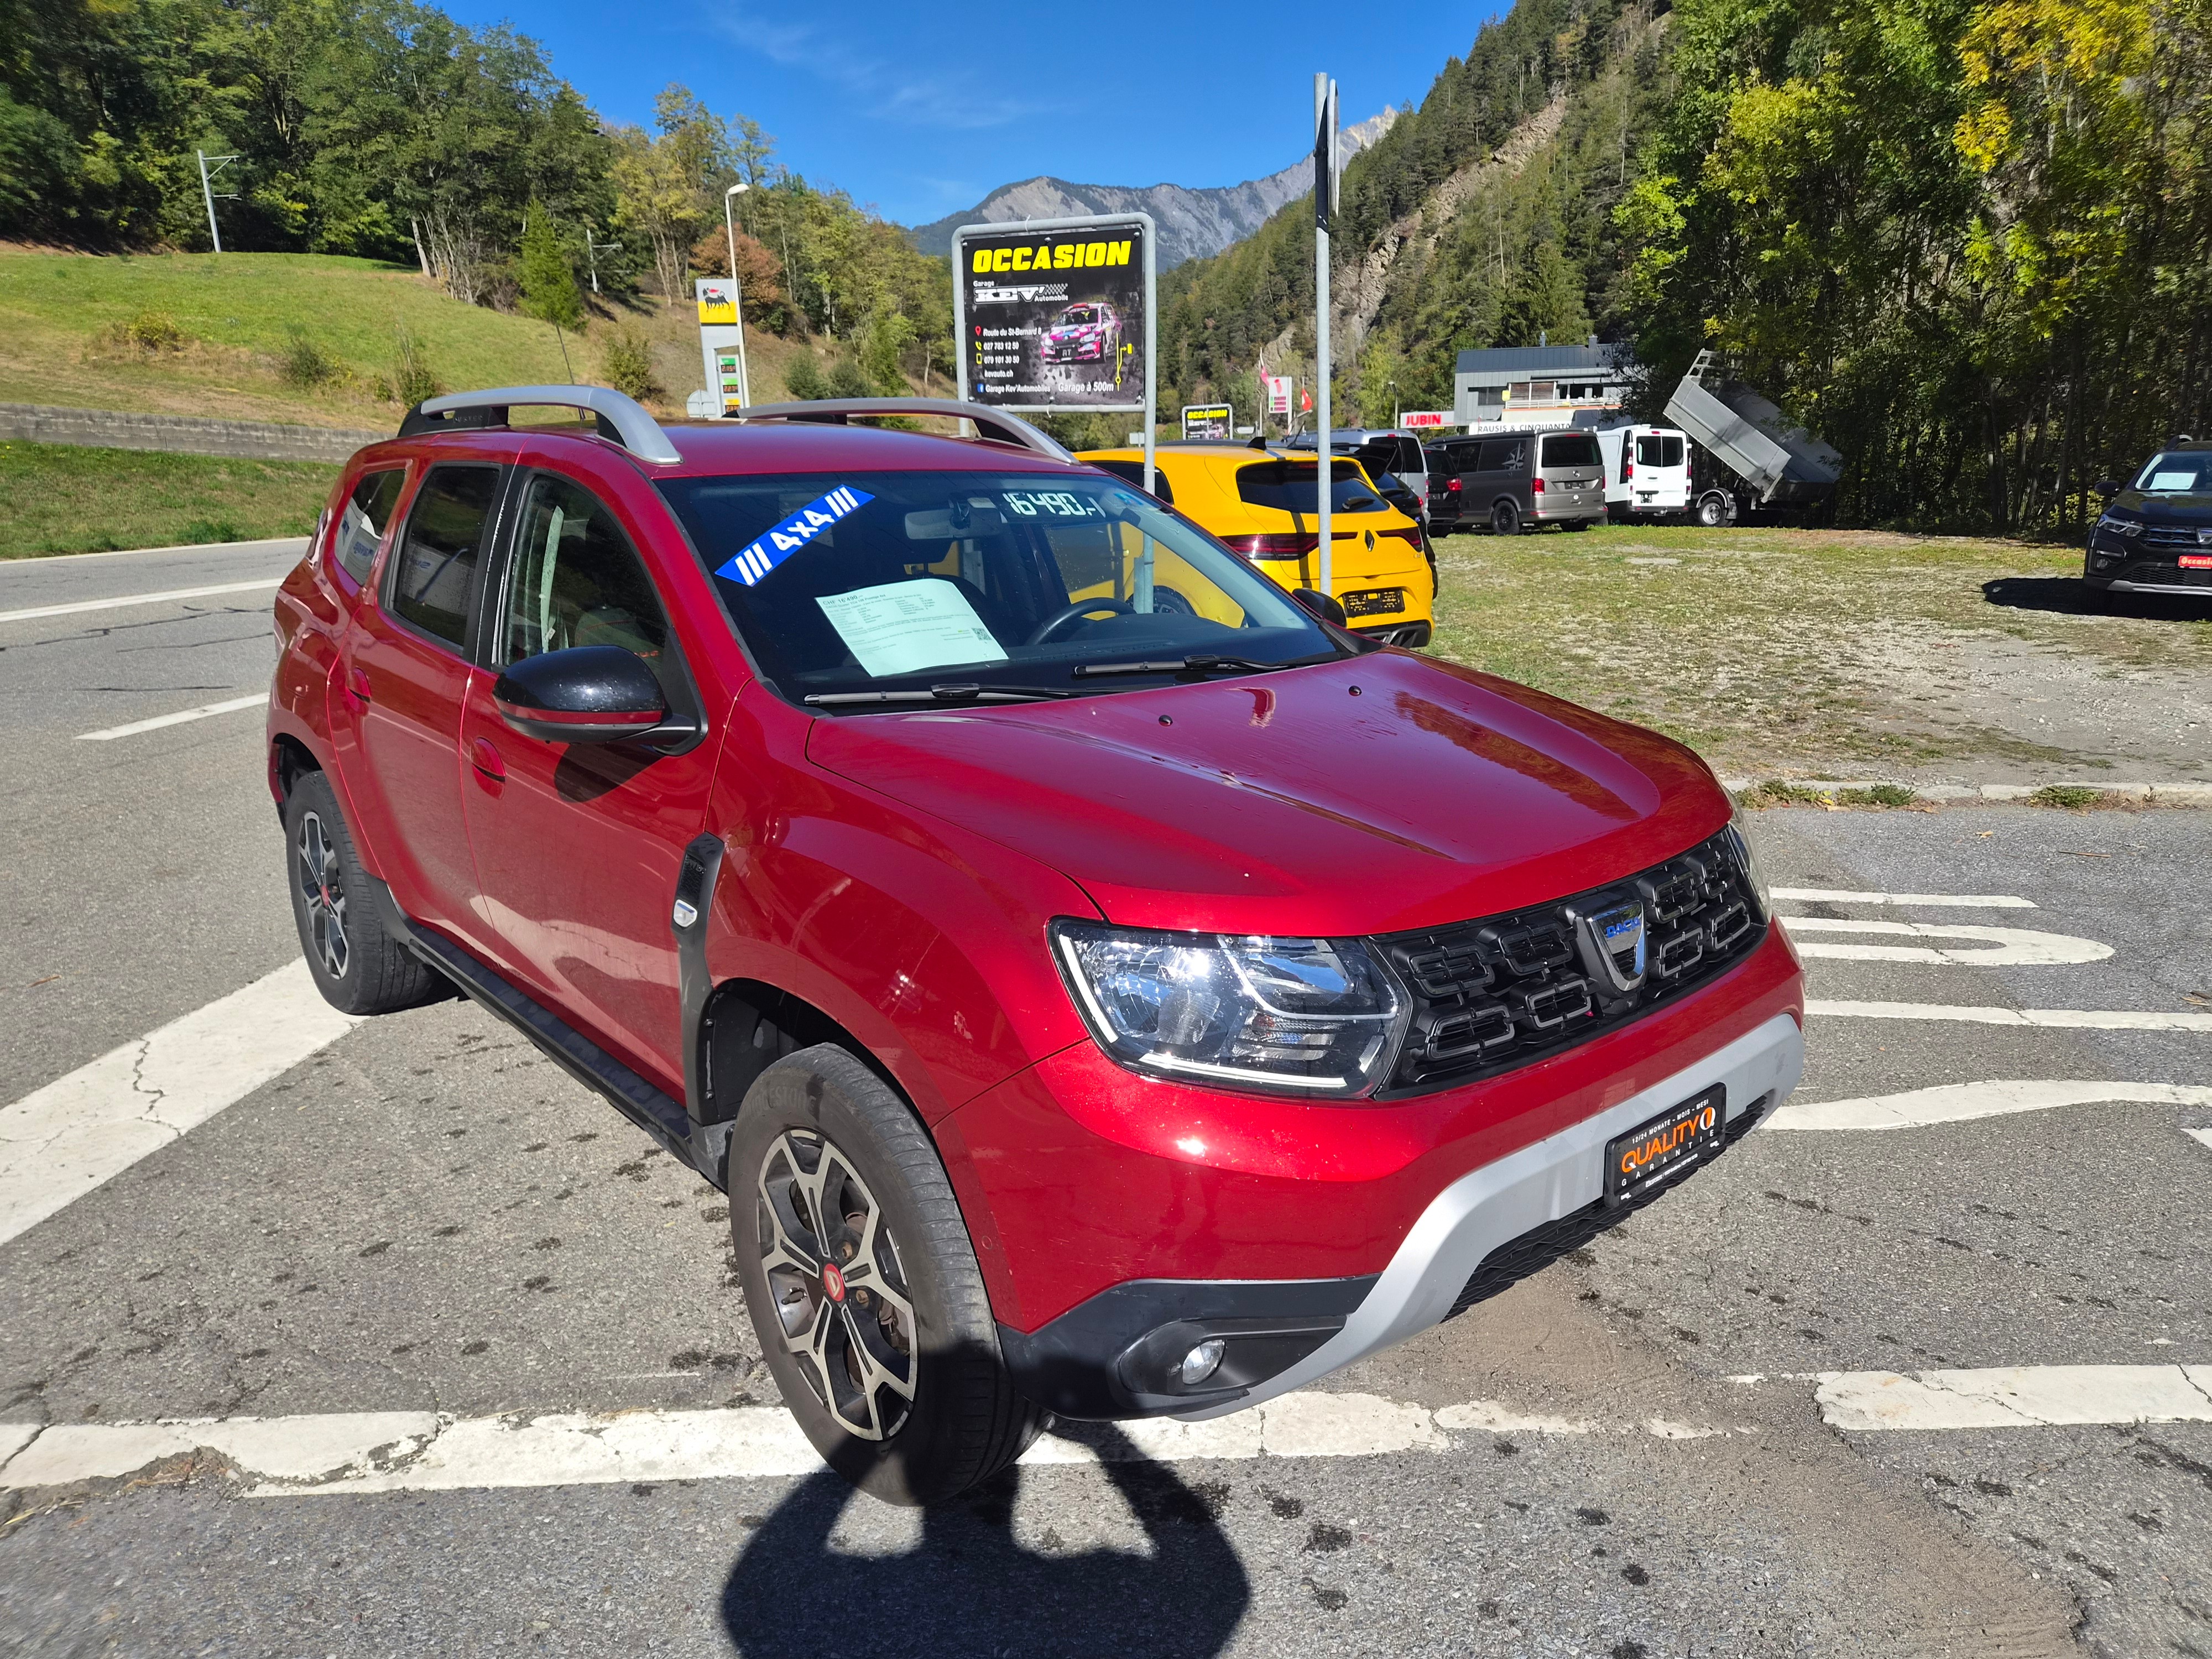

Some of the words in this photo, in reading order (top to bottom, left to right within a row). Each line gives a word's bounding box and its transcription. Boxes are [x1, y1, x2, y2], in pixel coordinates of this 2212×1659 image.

[973, 241, 1131, 273] OCCASION
[983, 328, 999, 337] Route
[1000, 328, 1008, 336] du
[1008, 327, 1037, 336] St-Bernard
[983, 342, 993, 350] 027
[994, 341, 1004, 350] 783
[1005, 341, 1011, 349] 12
[1012, 341, 1019, 349] 50
[984, 356, 994, 364] 079
[995, 356, 1004, 364] 101
[1013, 355, 1020, 363] 50
[984, 369, 1014, 378] kevauto.ch
[985, 384, 1005, 394] Garage
[1005, 384, 1051, 393] Kev'Automobiles
[1058, 382, 1085, 394] Garage
[1086, 381, 1092, 392] à
[1093, 381, 1114, 392] 500m
[1187, 409, 1228, 419] OCCASION
[1406, 414, 1441, 426] JUBIN
[1478, 425, 1507, 433] RAUSIS
[1520, 423, 1571, 431] CINQUANTA
[770, 510, 835, 551] 4x4
[1606, 916, 1641, 938] DACIA
[1632, 1131, 1647, 1144] 12/24
[1648, 1119, 1671, 1135] MONATE
[1677, 1109, 1691, 1121] MOIS
[1696, 1098, 1709, 1110] MESI
[1621, 1130, 1714, 1187] GARANTIE
